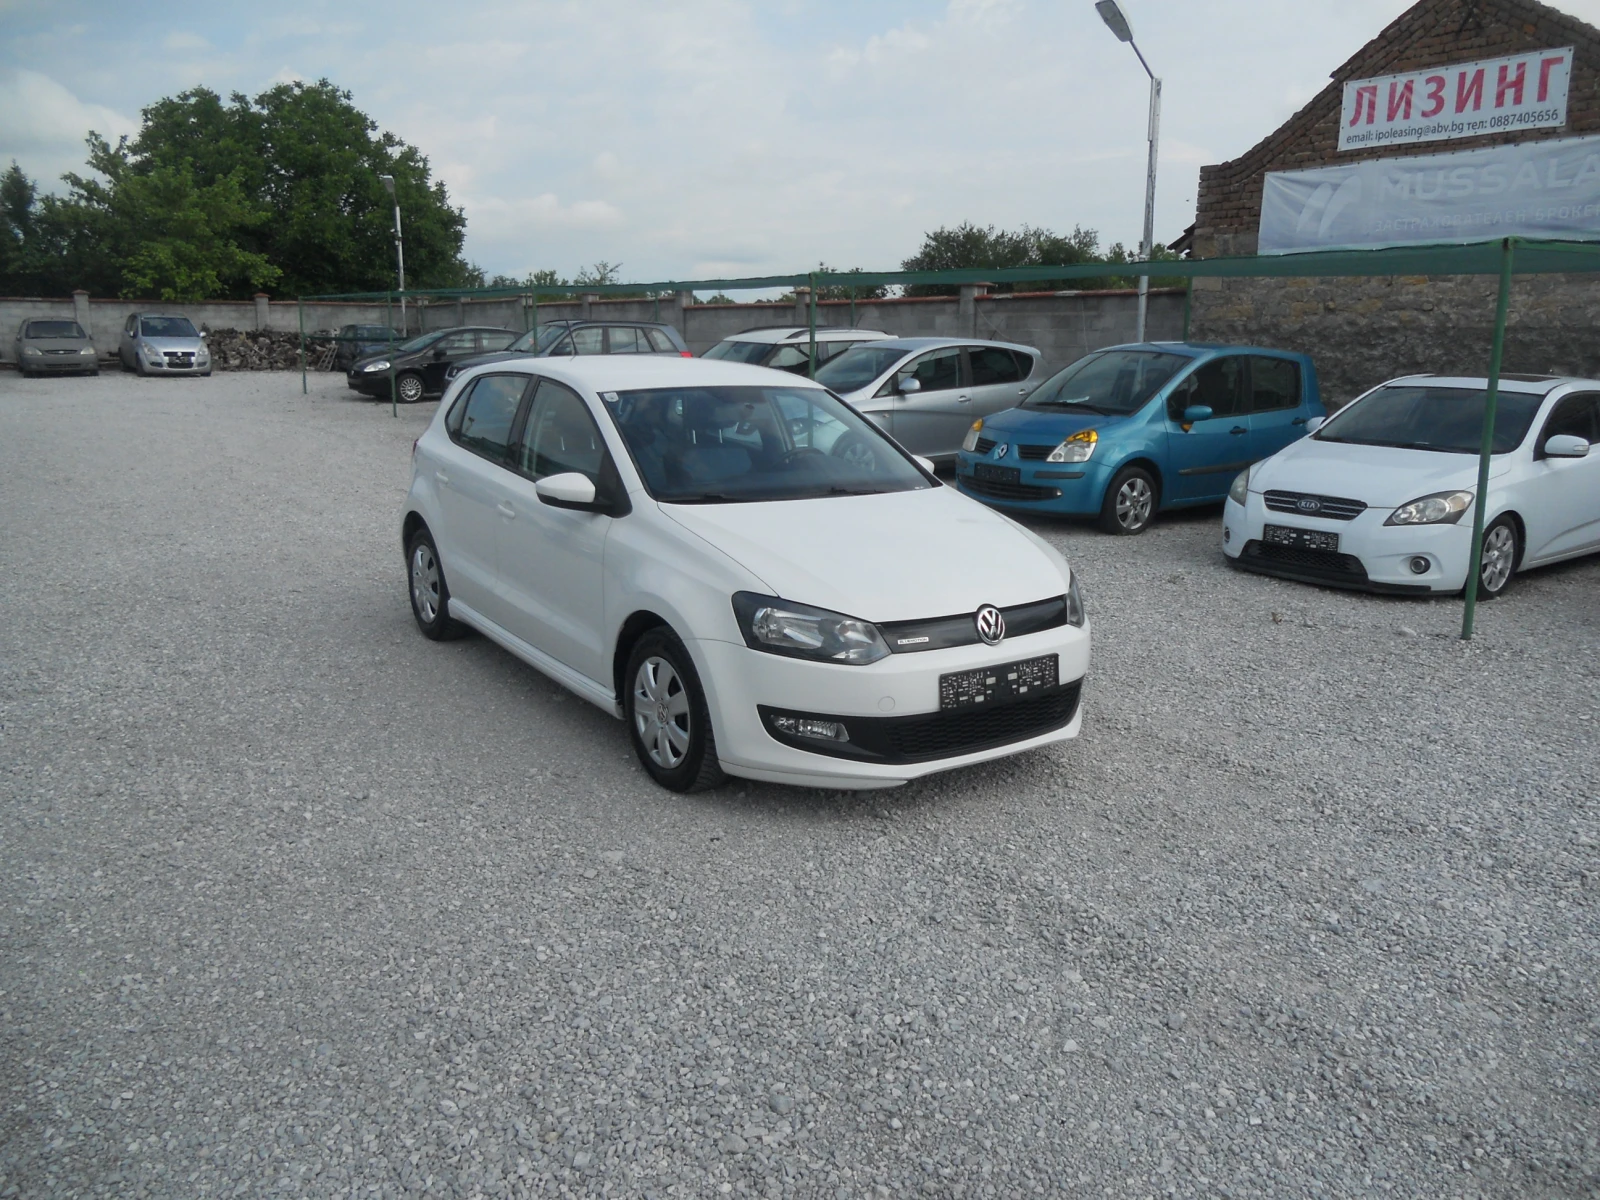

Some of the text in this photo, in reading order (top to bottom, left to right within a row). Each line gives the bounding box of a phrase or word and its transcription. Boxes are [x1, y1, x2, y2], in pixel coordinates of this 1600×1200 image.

[1349, 56, 1564, 127] ЛИЗИНГ
[1346, 109, 1559, 144] email: ipoleasing@abv.bg тел: 0887405656
[1378, 153, 1600, 202] MUSSALA
[1300, 501, 1316, 509] KIA
